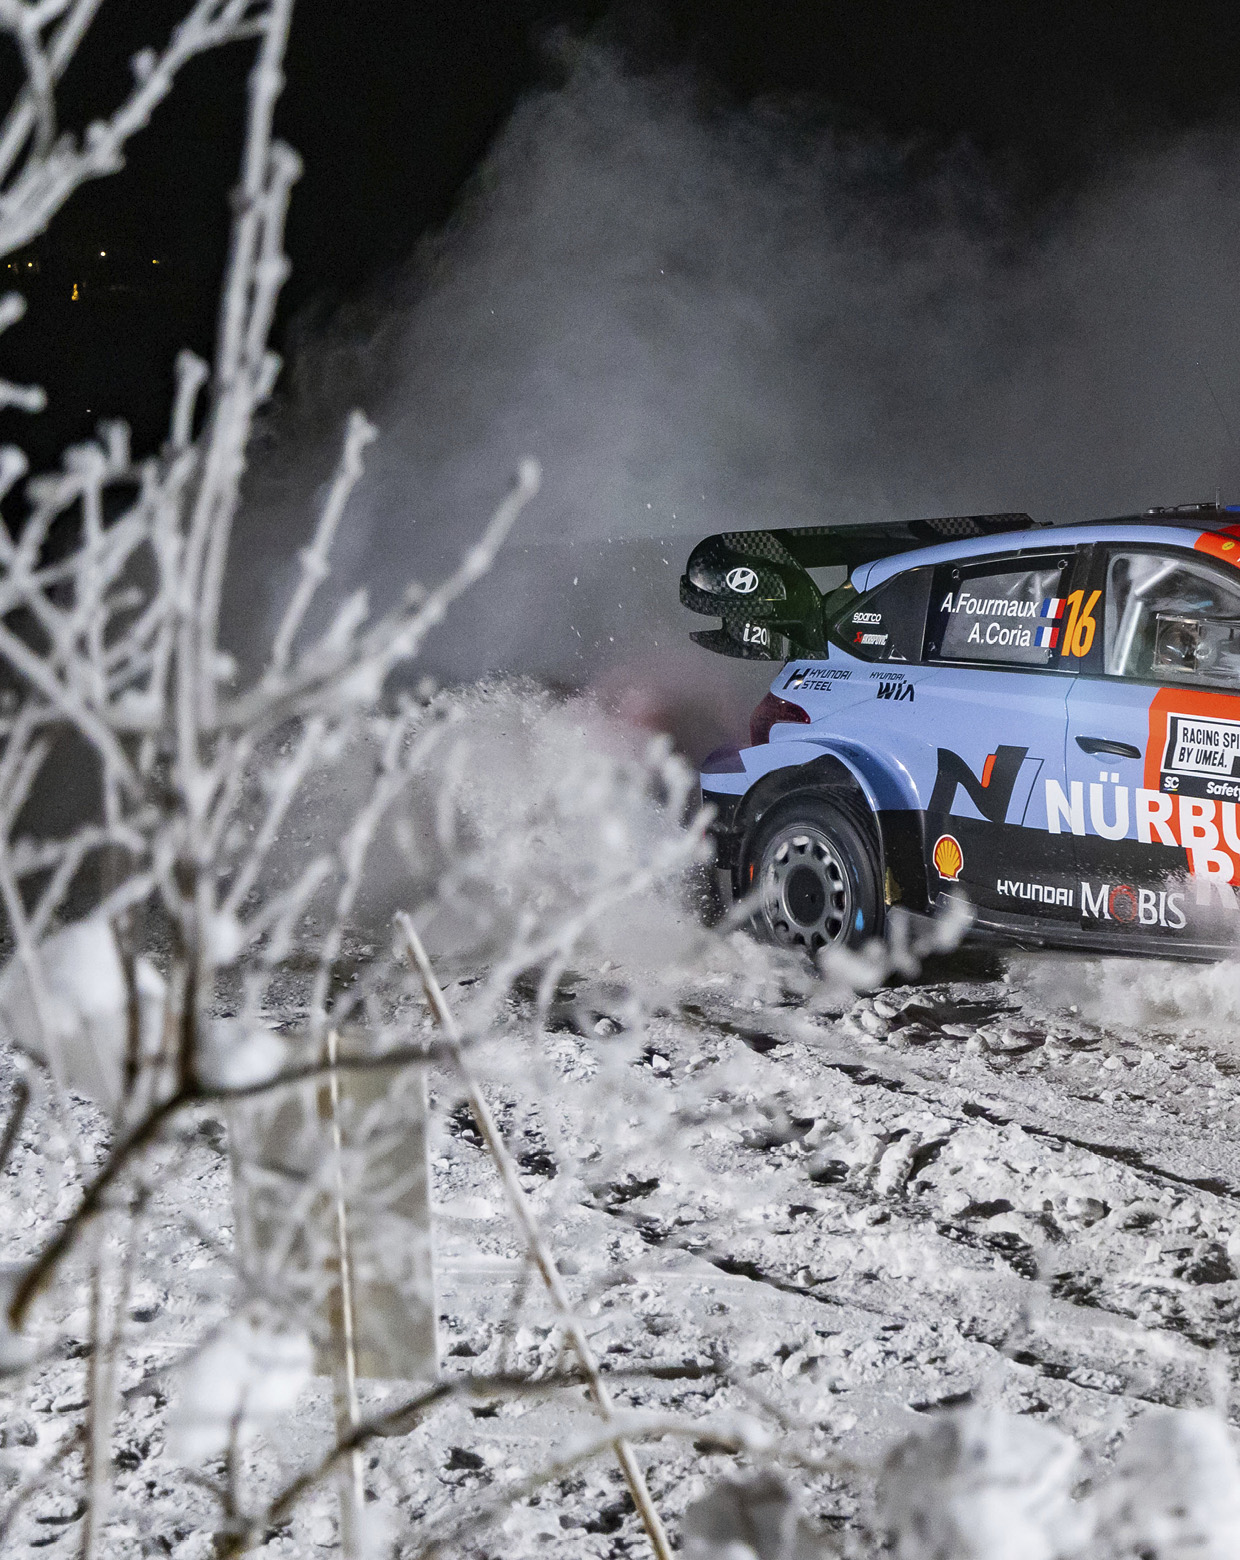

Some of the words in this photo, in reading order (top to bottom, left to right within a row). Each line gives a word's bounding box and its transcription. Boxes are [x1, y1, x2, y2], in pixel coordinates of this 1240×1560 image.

[940, 592, 1039, 618] A.Fourmaux
[852, 612, 881, 624] sparco
[1061, 589, 1102, 658] 16
[967, 622, 1031, 647] A.Coria
[808, 669, 852, 680] HYUNDAI
[869, 672, 905, 681] HYUNDAI
[801, 681, 832, 691] STEEL
[1182, 727, 1220, 747] RACING
[1178, 747, 1192, 764] BY
[1164, 776, 1180, 790] SC
[997, 880, 1073, 907] HYUNDAI
[1081, 882, 1187, 929] MOBIS
